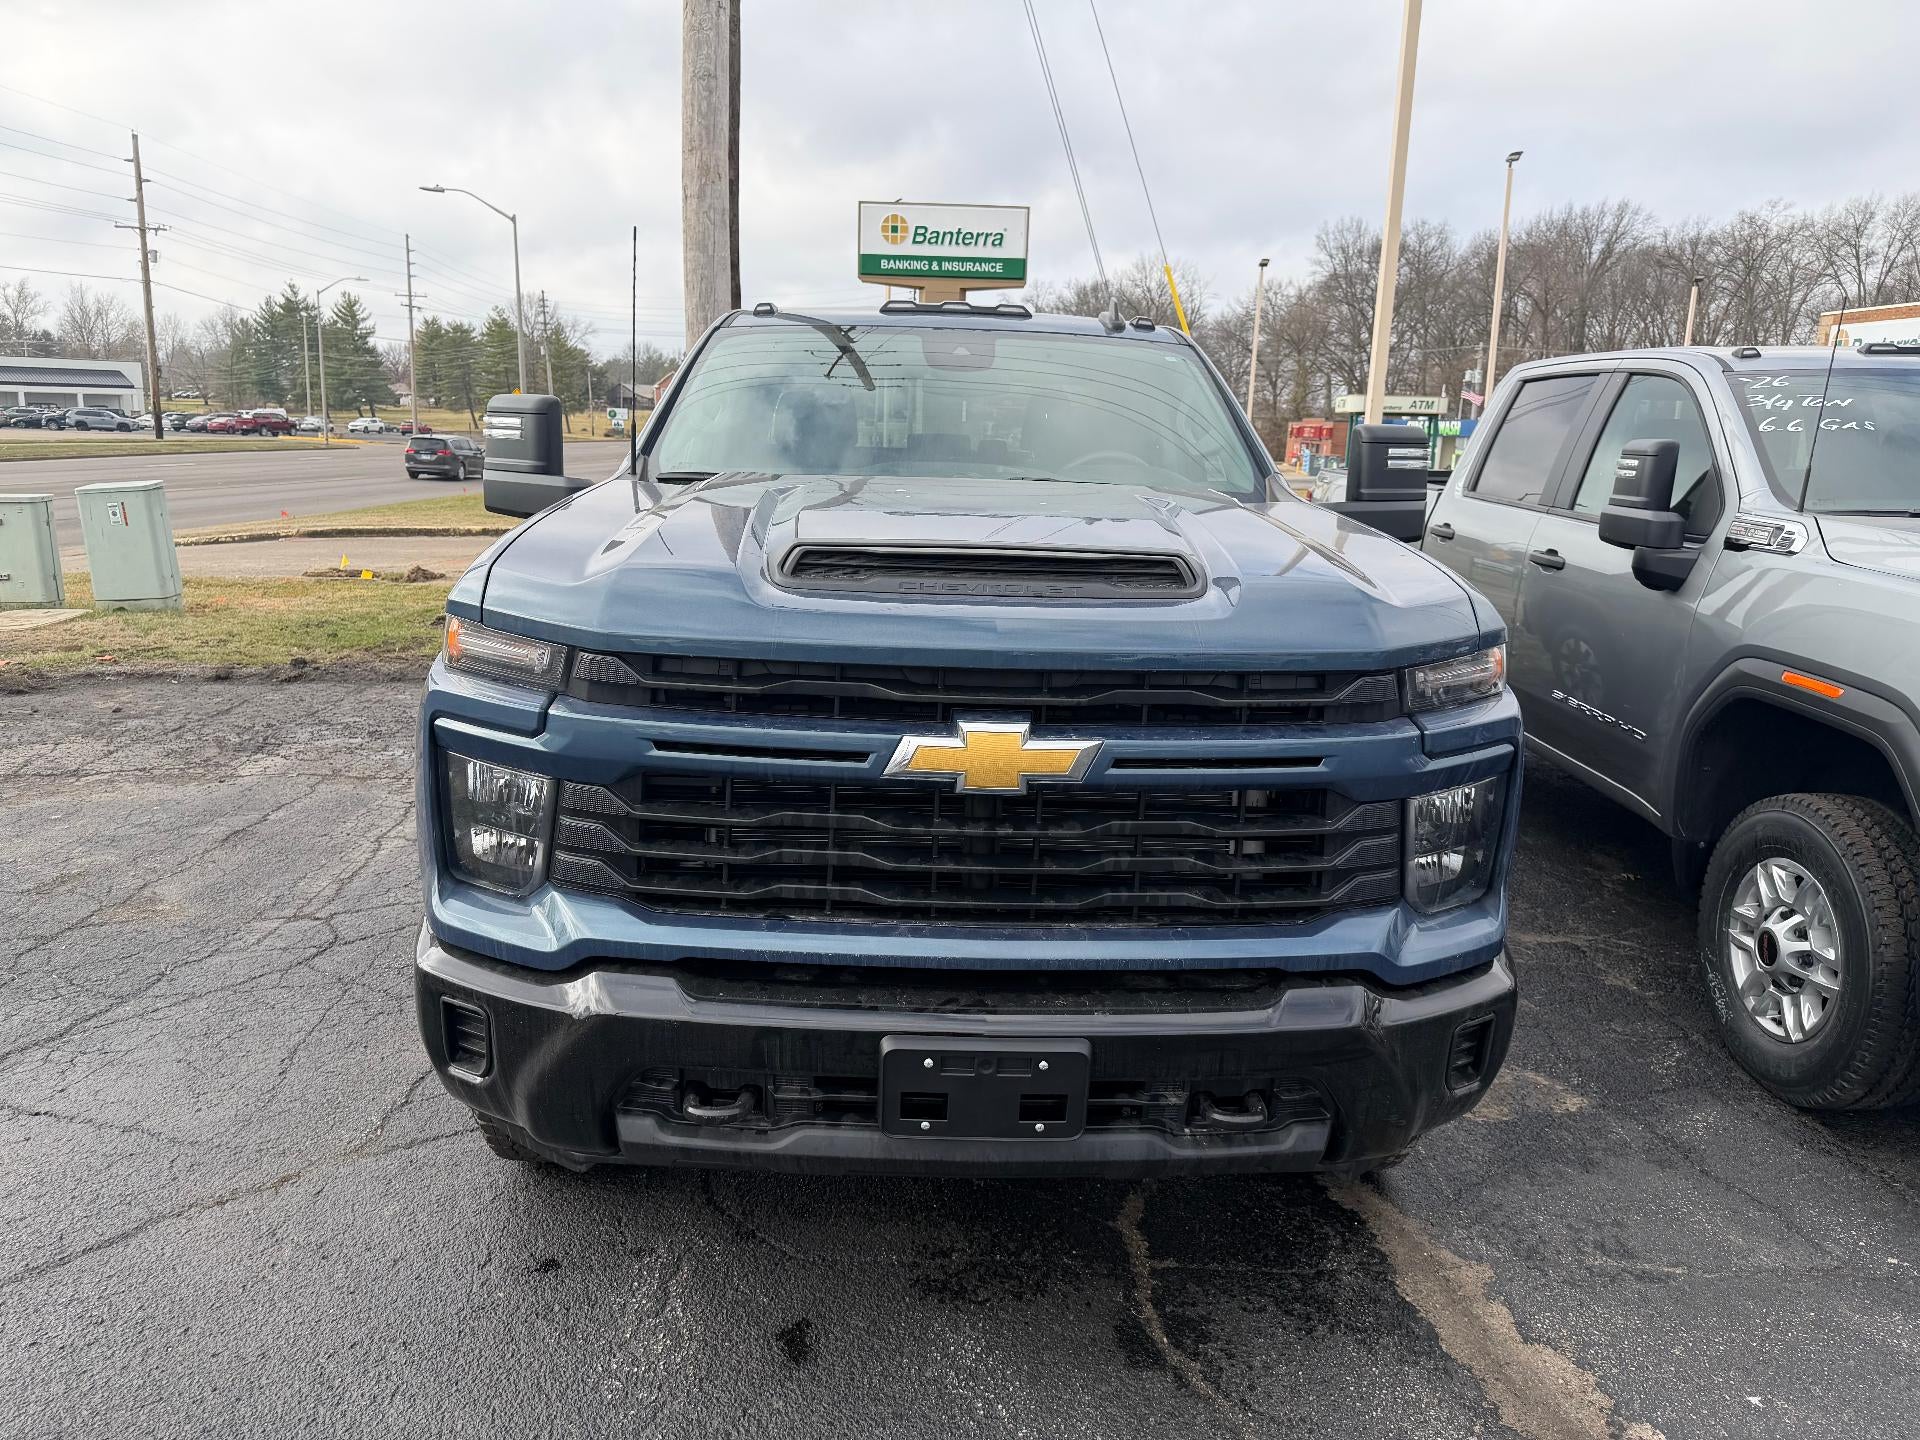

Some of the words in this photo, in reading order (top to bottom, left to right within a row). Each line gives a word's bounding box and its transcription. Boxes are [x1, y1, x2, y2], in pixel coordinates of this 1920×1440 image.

[911, 225, 1004, 248] Banterra
[880, 259, 929, 271] BANKING
[931, 261, 940, 272] &
[941, 261, 1004, 273] INSURANCE
[1408, 400, 1435, 411] ATM
[1745, 393, 1794, 410] 3/4
[1438, 420, 1462, 436] WASH
[1819, 418, 1876, 431] GAS
[898, 581, 1084, 597] CHEVROLET
